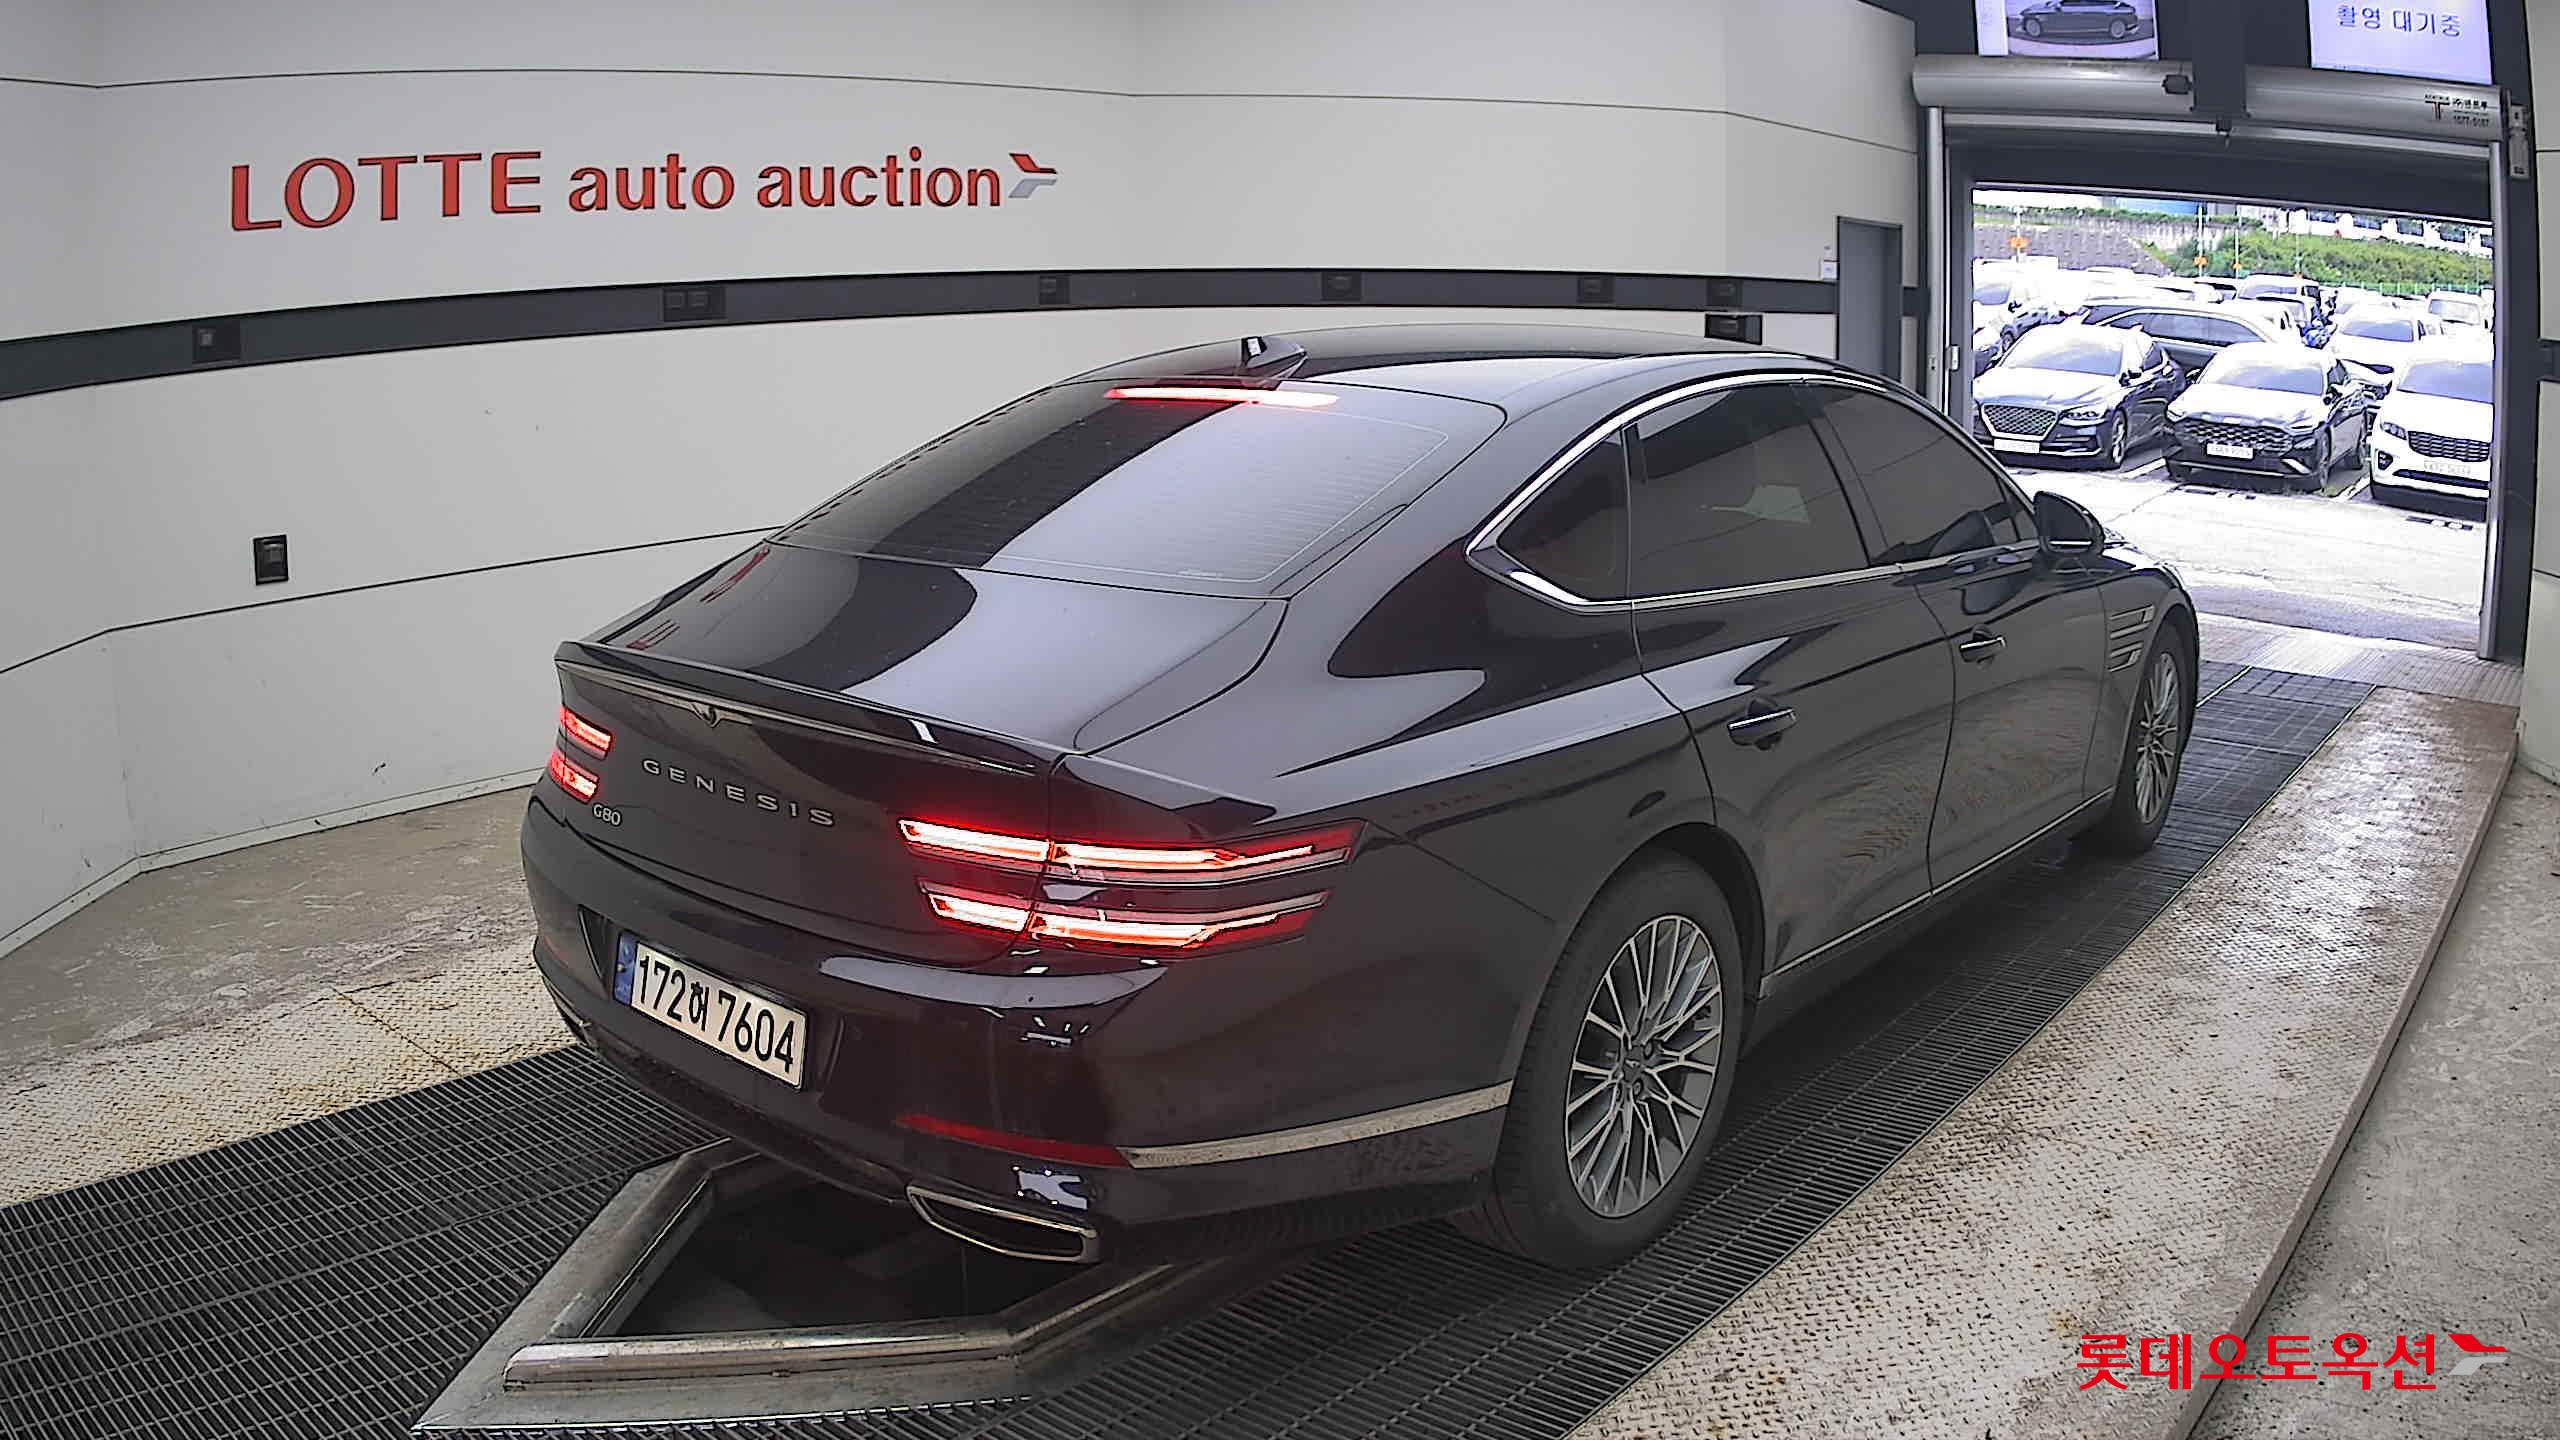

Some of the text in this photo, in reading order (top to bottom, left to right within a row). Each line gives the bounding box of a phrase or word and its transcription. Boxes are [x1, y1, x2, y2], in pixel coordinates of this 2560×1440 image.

[2337, 4, 2461, 38] 촬영 대기중
[231, 147, 1002, 232] LOTTE auto auction
[592, 803, 623, 827] G80
[642, 758, 835, 827] GENESIS
[717, 988, 796, 1074] 7604
